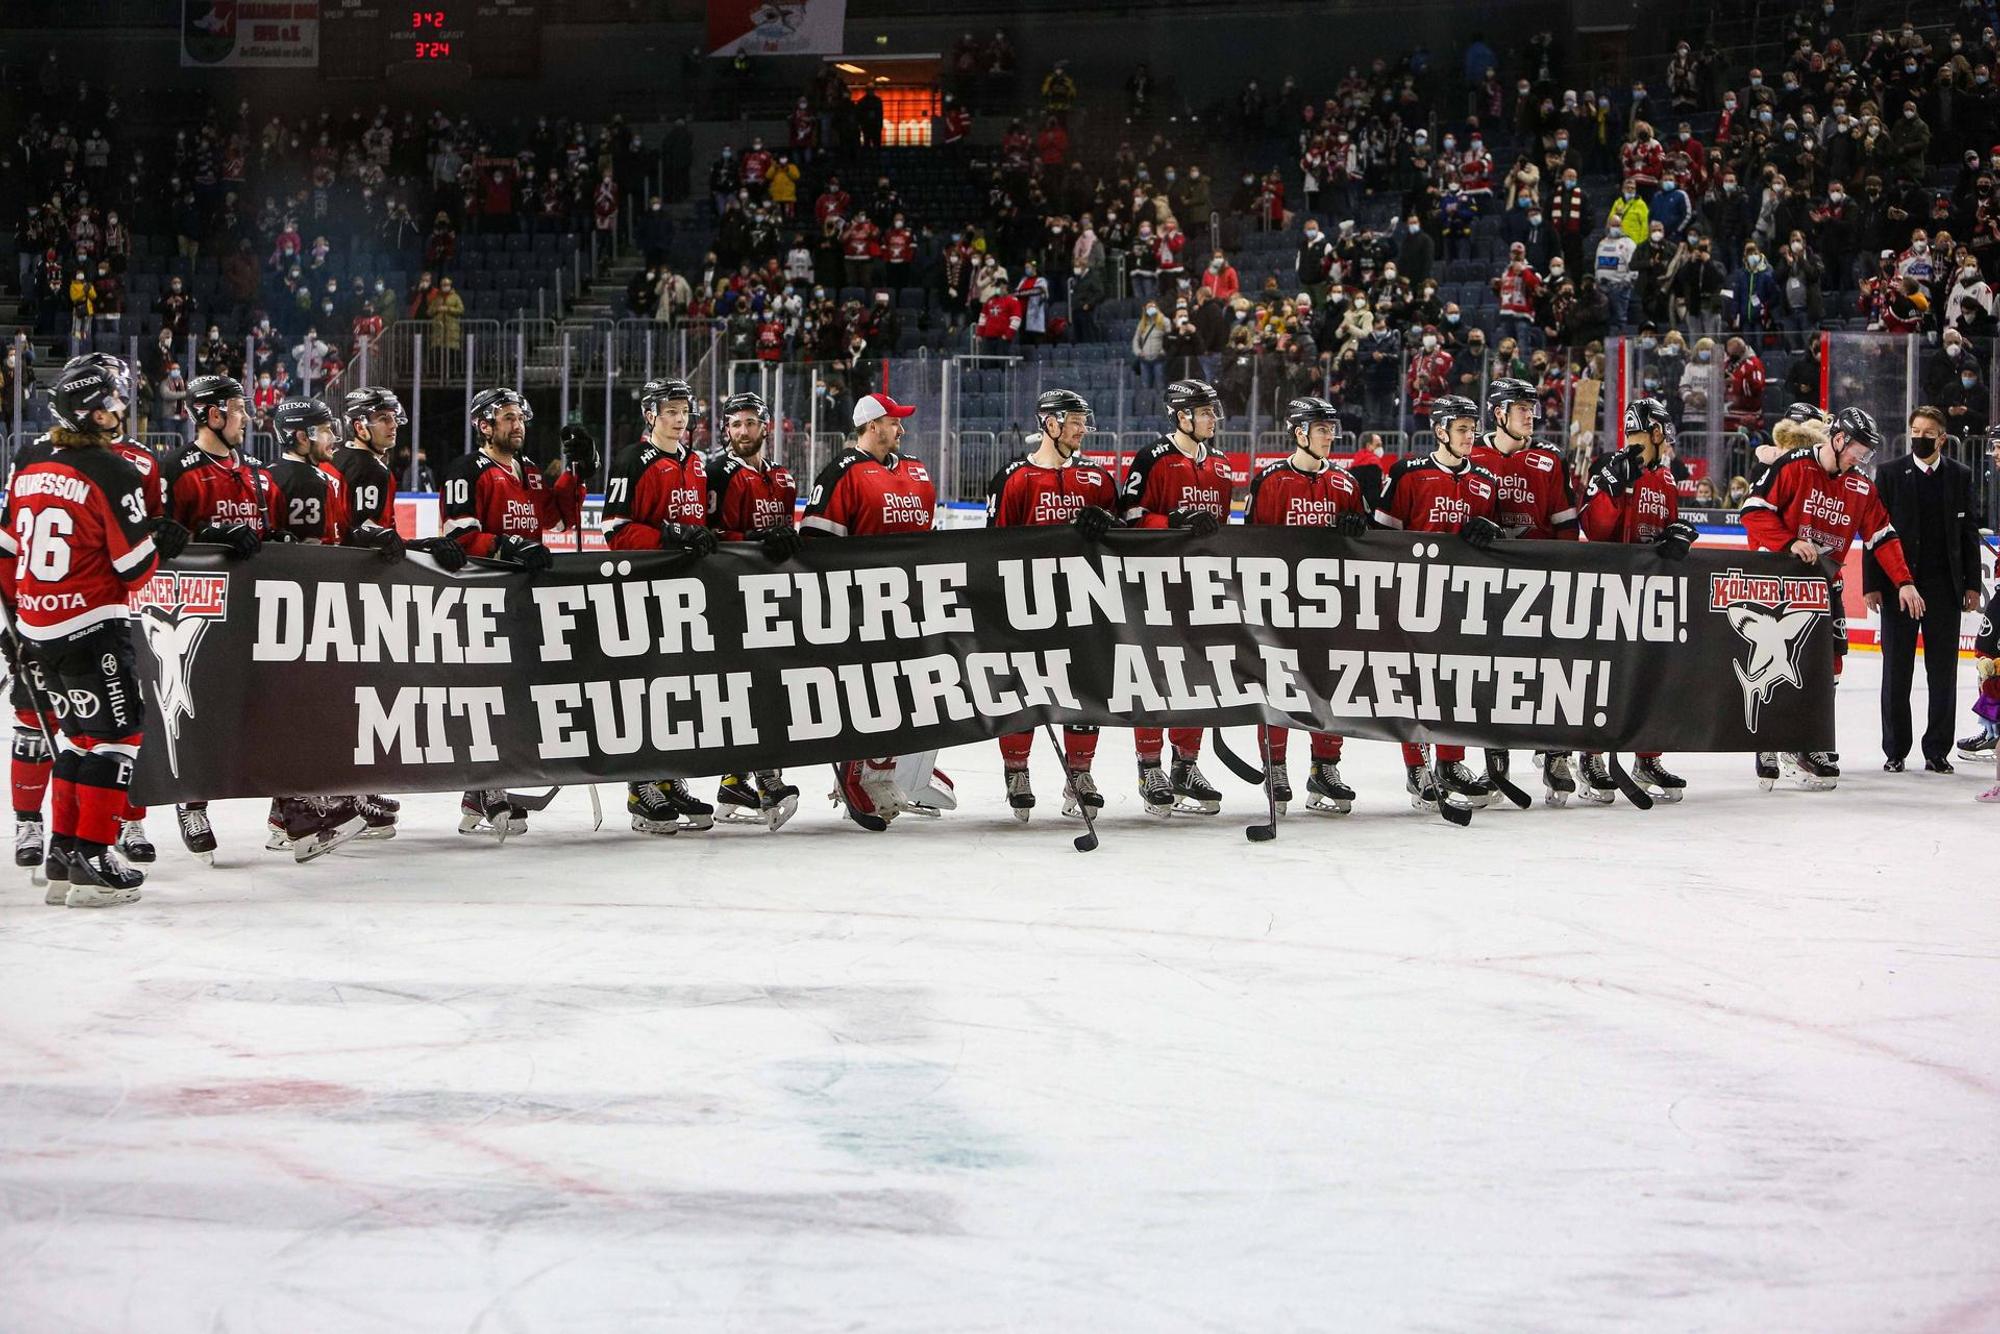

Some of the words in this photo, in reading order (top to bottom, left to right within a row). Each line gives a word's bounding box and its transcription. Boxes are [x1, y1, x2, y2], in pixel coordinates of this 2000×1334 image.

[63, 375, 102, 392] STETSON
[1168, 383, 1194, 396] STETSON
[278, 402, 310, 412] STETSON
[181, 450, 201, 467] HIT
[1151, 443, 1170, 458] HIT
[1791, 449, 1812, 460] HIT
[1407, 457, 1429, 468] HIT
[1124, 471, 1142, 496] 2
[1496, 474, 1527, 489] hein
[355, 485, 379, 511] 19
[445, 479, 470, 504] 10
[608, 478, 629, 503] 71
[671, 487, 699, 504] Rhein
[1182, 486, 1220, 502] Rhein
[1497, 487, 1535, 503] ergie
[1641, 487, 1666, 504] Rhein
[884, 492, 922, 509] Rhein
[1040, 492, 1085, 507] Rhein
[1291, 498, 1336, 513] Rhein
[1435, 497, 1470, 514] Rhein
[1811, 489, 1845, 512] Rhein
[216, 499, 258, 518] Rhein
[289, 498, 321, 525] 23
[882, 507, 929, 526] Energie
[16, 506, 74, 582] 36
[180, 578, 225, 610] HAIE
[1713, 572, 1778, 607] KÖLNER
[1784, 581, 1829, 608] HAIE
[253, 580, 512, 663] DANKE
[531, 560, 715, 662] FÜR
[738, 562, 974, 650] EURE
[998, 543, 1688, 645] UNTERSTÜTZUNG!
[106, 682, 127, 727] Hilux
[354, 687, 505, 765] MIT
[530, 671, 759, 760] EUCH
[781, 648, 1082, 742] DURCH
[1108, 643, 1311, 713] ALLE
[1329, 650, 1610, 728] ZEITEN!
